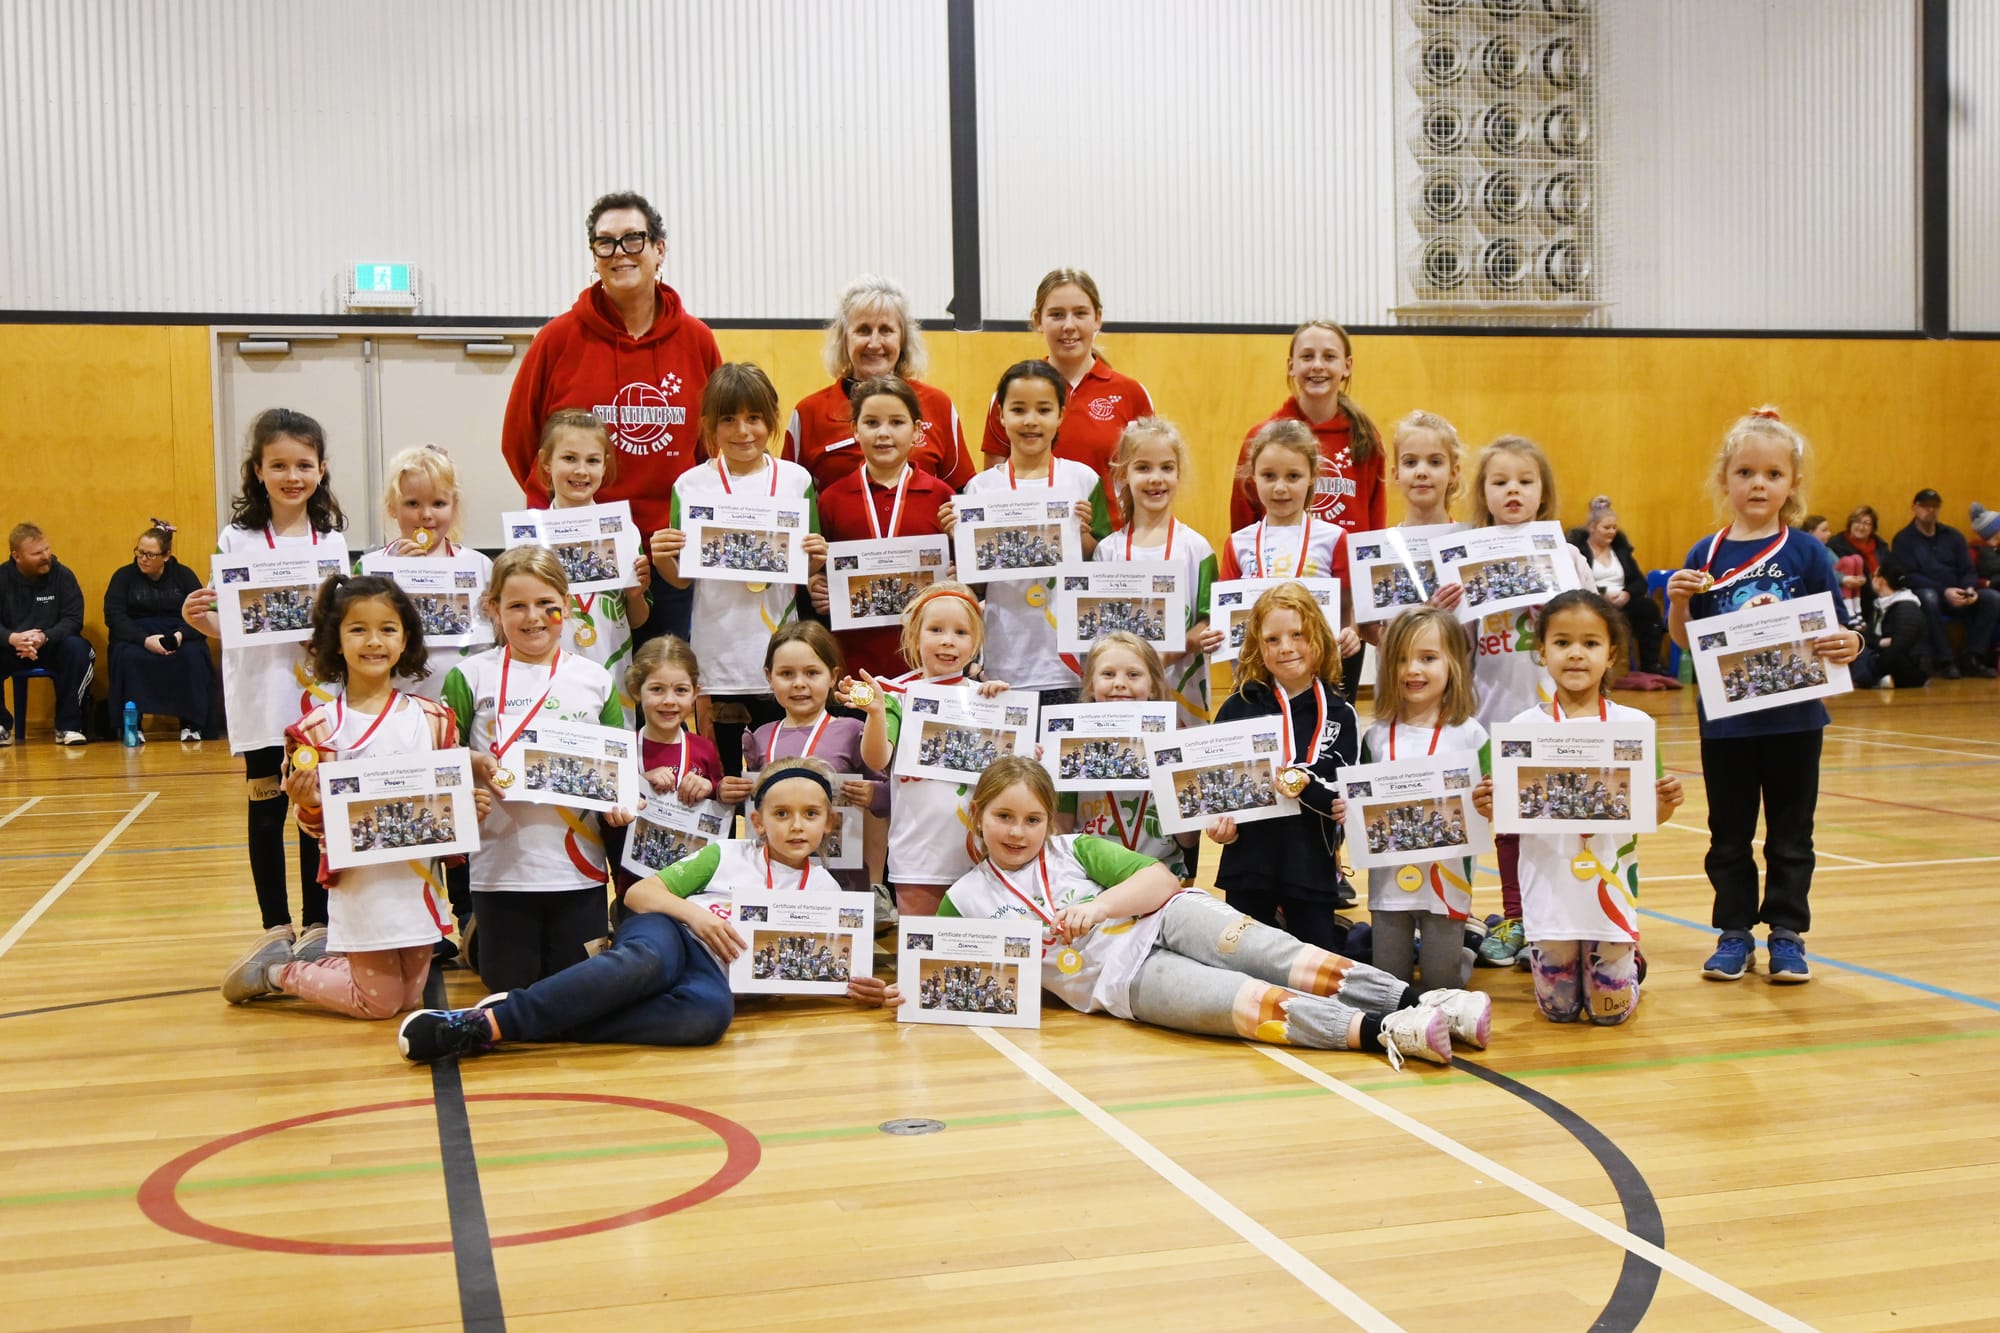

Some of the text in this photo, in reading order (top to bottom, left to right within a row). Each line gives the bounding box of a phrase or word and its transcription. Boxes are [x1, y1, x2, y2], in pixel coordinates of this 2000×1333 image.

[651, 432, 674, 452] CLUB
[1479, 629, 1513, 657] set
[1557, 747, 1582, 755] Daisy
[253, 786, 278, 798] Nora
[1390, 782, 1423, 790] Florence
